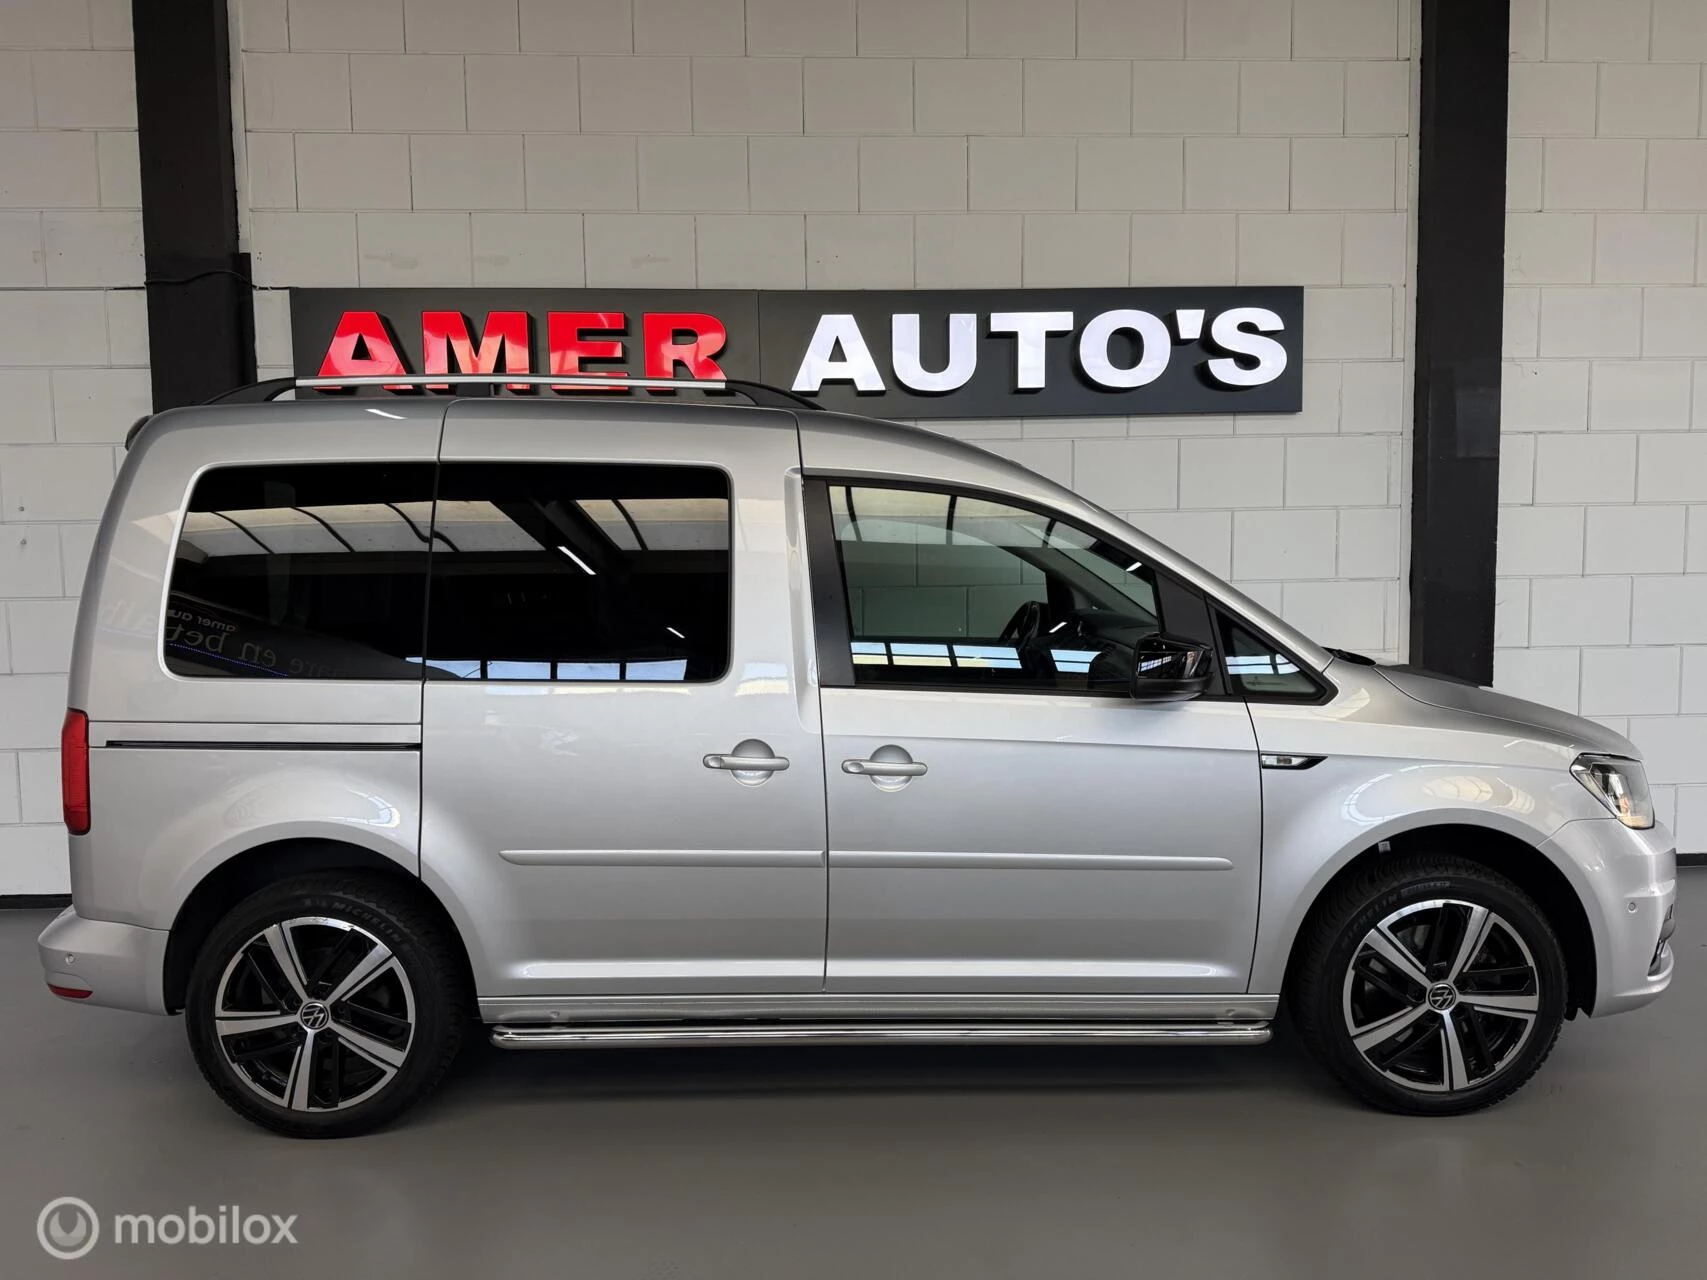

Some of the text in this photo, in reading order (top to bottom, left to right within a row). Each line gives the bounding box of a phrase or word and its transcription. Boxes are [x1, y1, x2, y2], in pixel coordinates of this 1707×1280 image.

[313, 307, 1289, 393] AMER AUTO'S
[331, 900, 402, 943] MICHELIN
